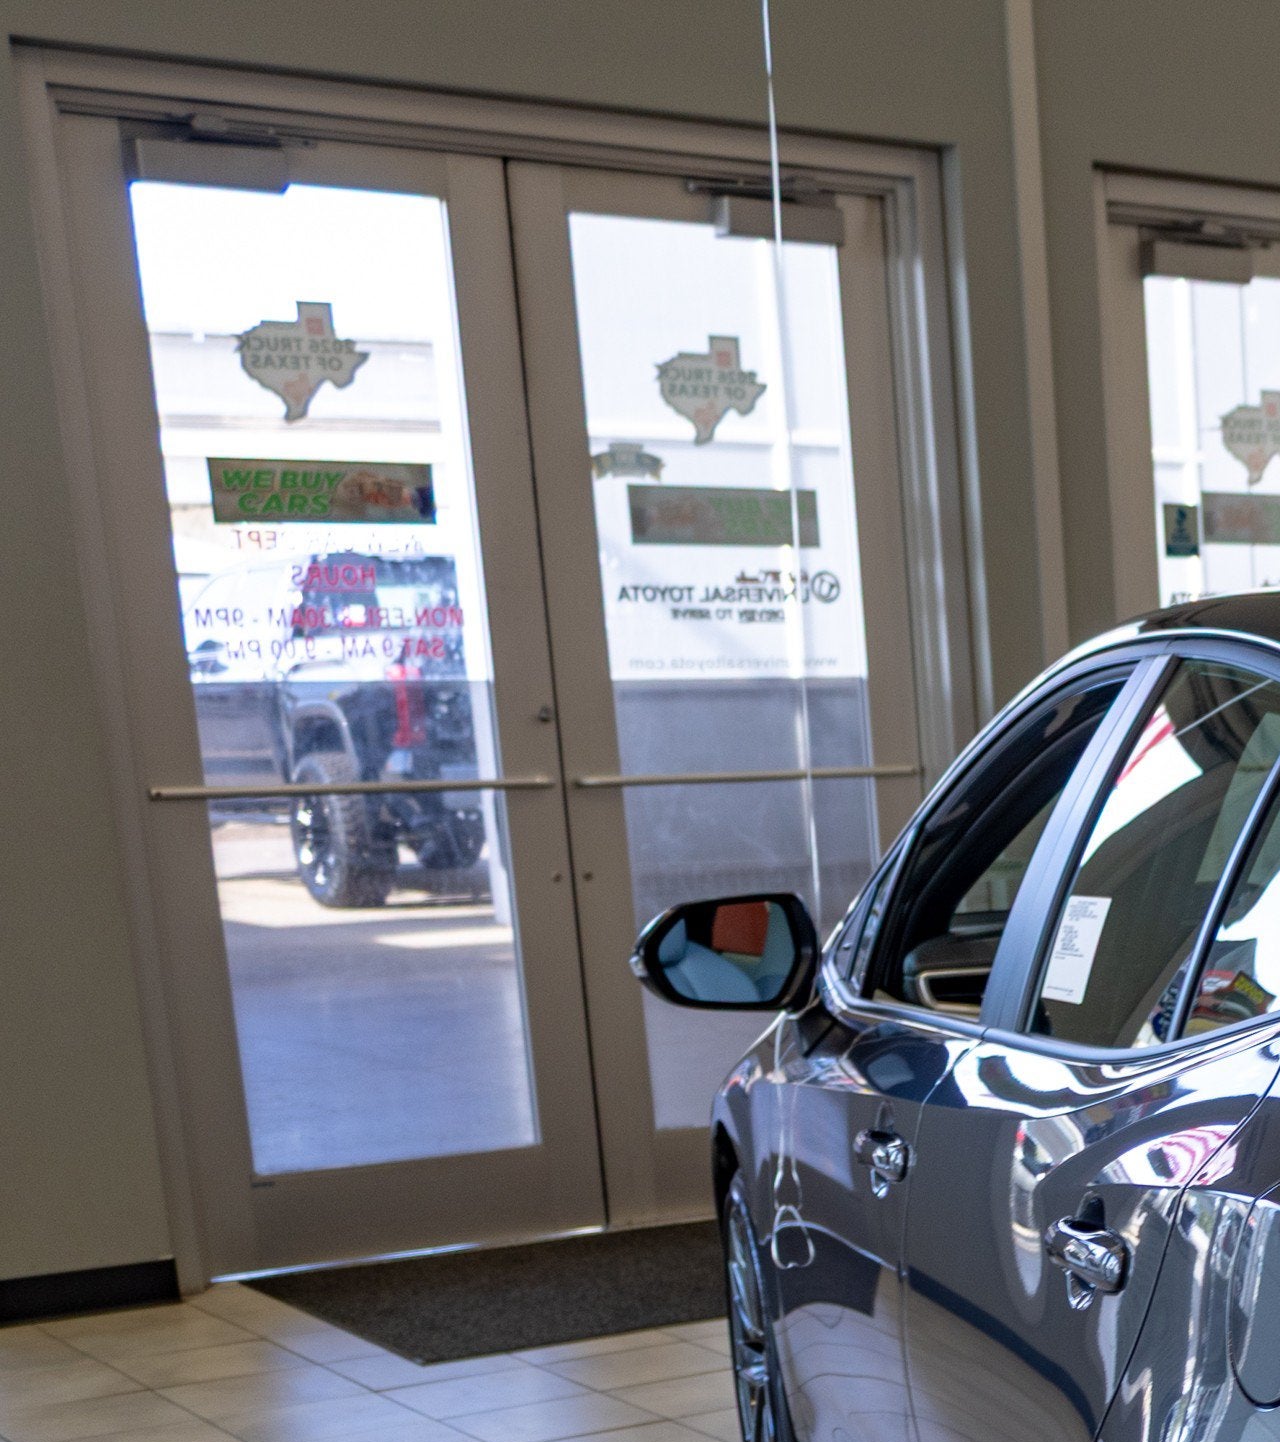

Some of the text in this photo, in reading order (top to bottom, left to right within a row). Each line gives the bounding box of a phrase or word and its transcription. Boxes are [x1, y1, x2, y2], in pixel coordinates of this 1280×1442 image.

[222, 469, 342, 490] WE BUY
[238, 492, 331, 514] CARS
